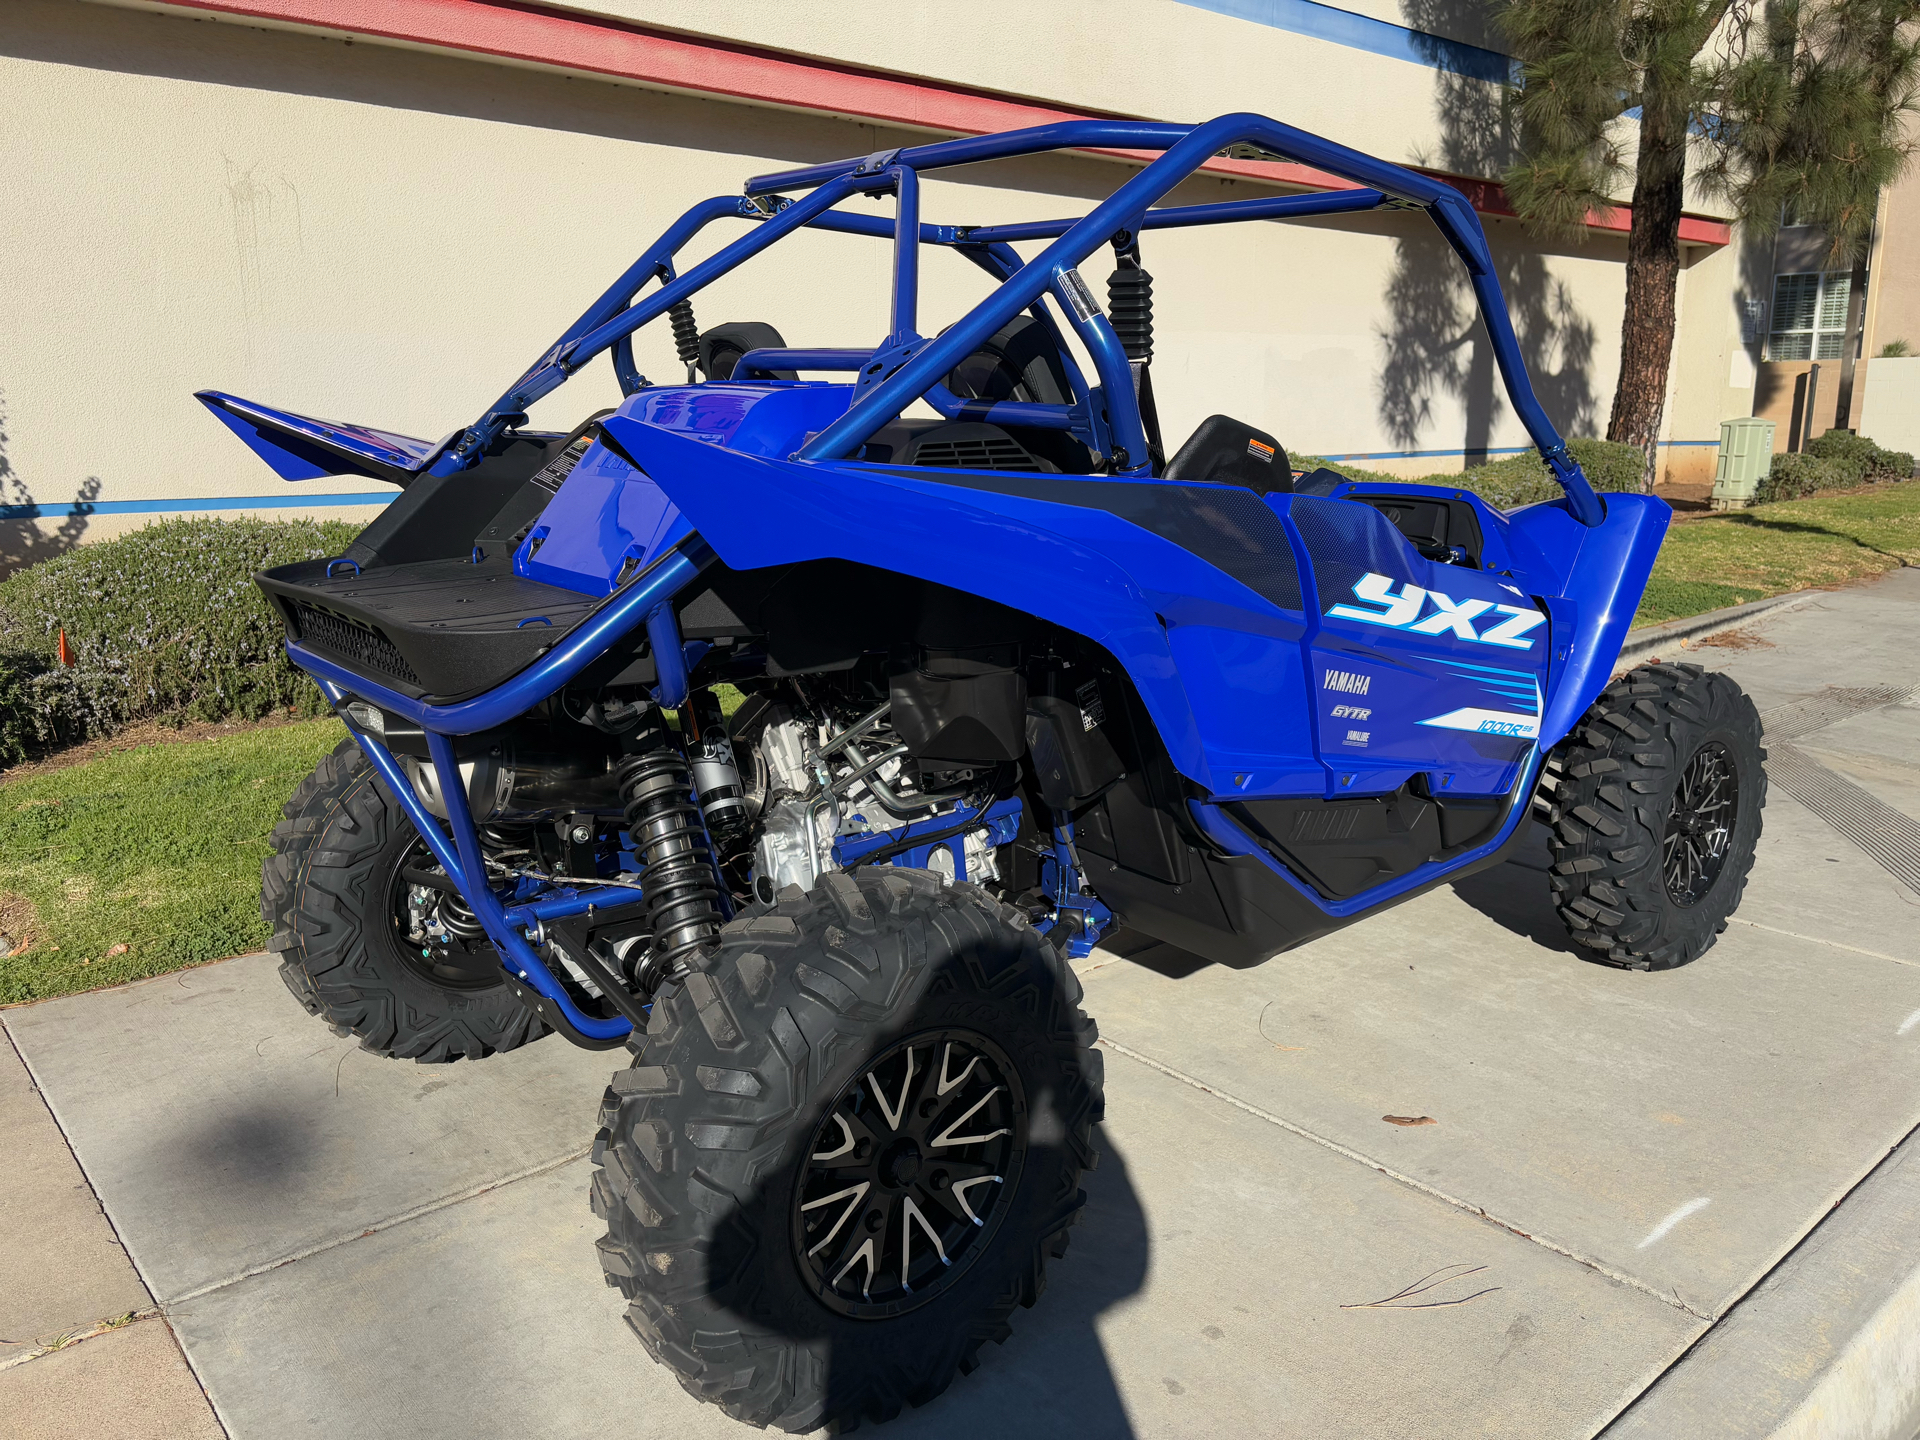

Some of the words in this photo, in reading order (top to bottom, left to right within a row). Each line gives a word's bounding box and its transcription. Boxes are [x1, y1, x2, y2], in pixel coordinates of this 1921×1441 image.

[1324, 572, 1547, 650] YXZ
[1323, 669, 1371, 696] YAMAHA
[1330, 704, 1372, 721] GYTR
